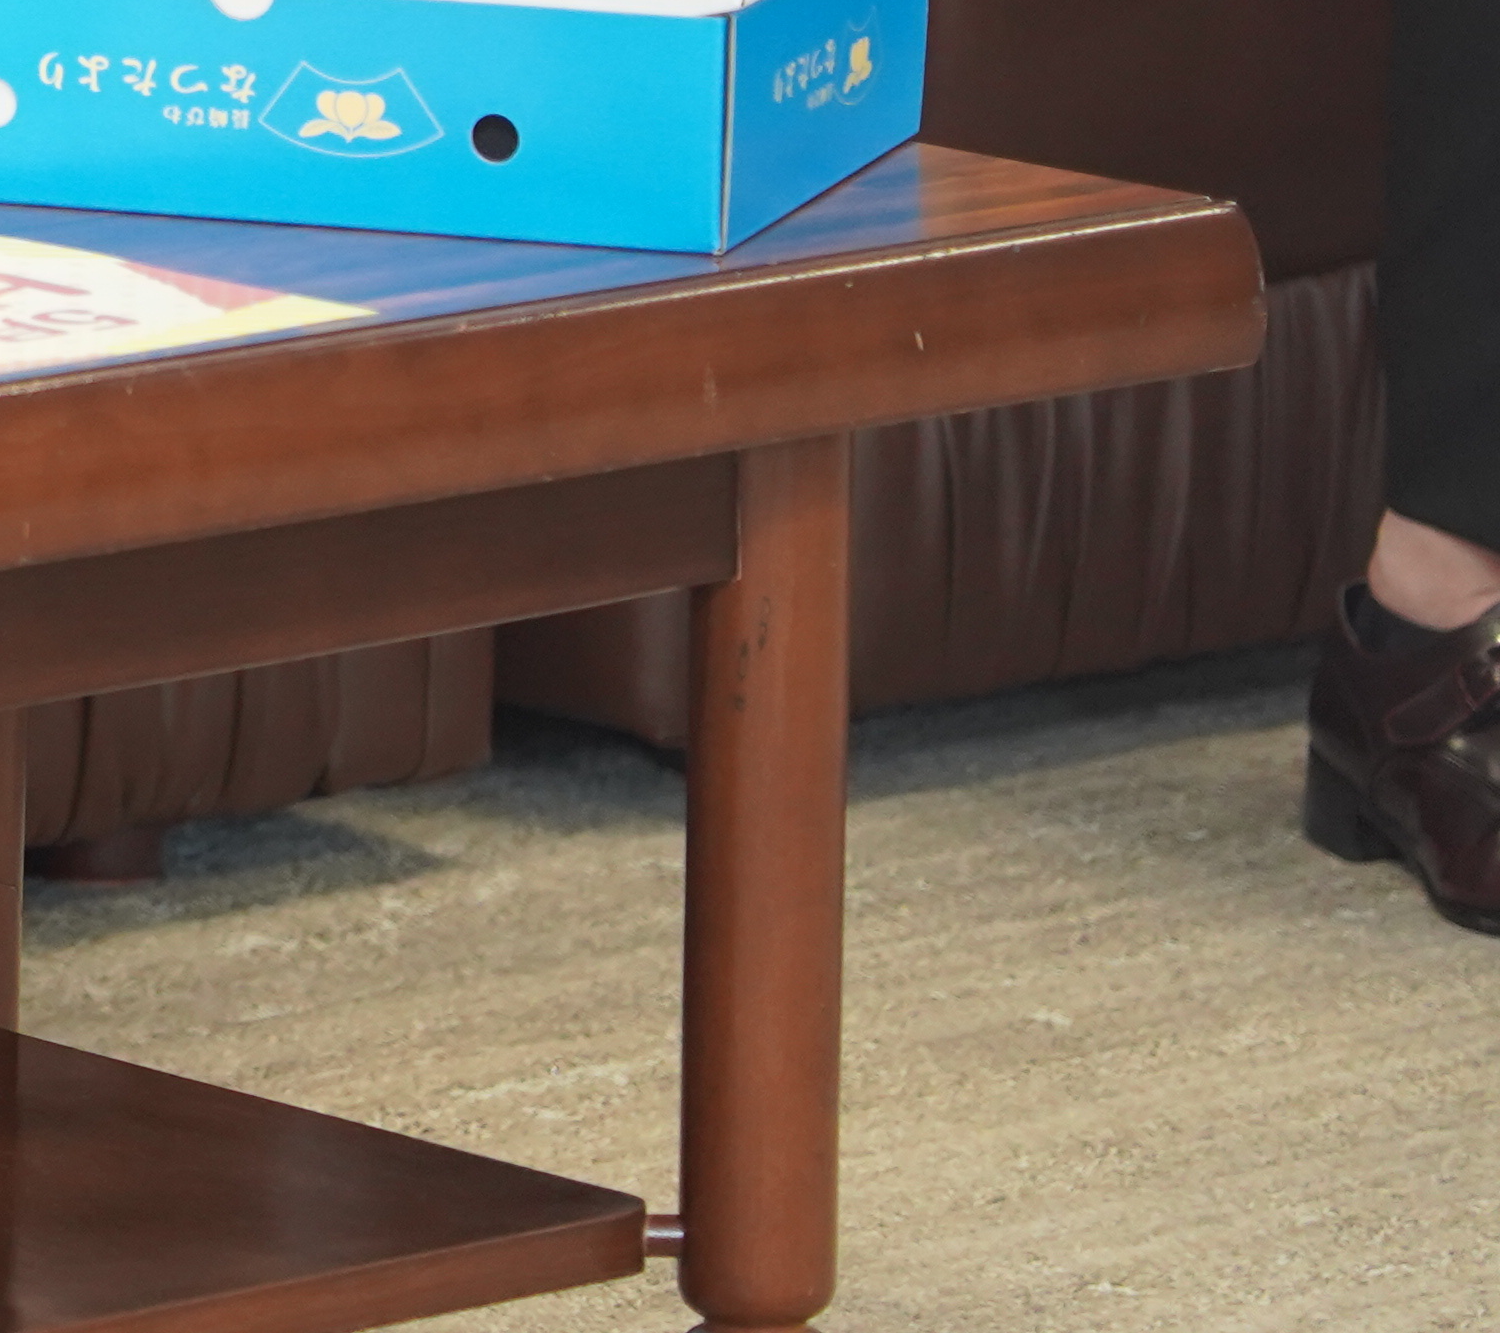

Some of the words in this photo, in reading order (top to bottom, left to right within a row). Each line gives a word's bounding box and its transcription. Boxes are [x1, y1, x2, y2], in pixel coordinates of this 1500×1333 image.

[37, 51, 257, 104] なつたより
[162, 105, 251, 130] 長崎びわ
